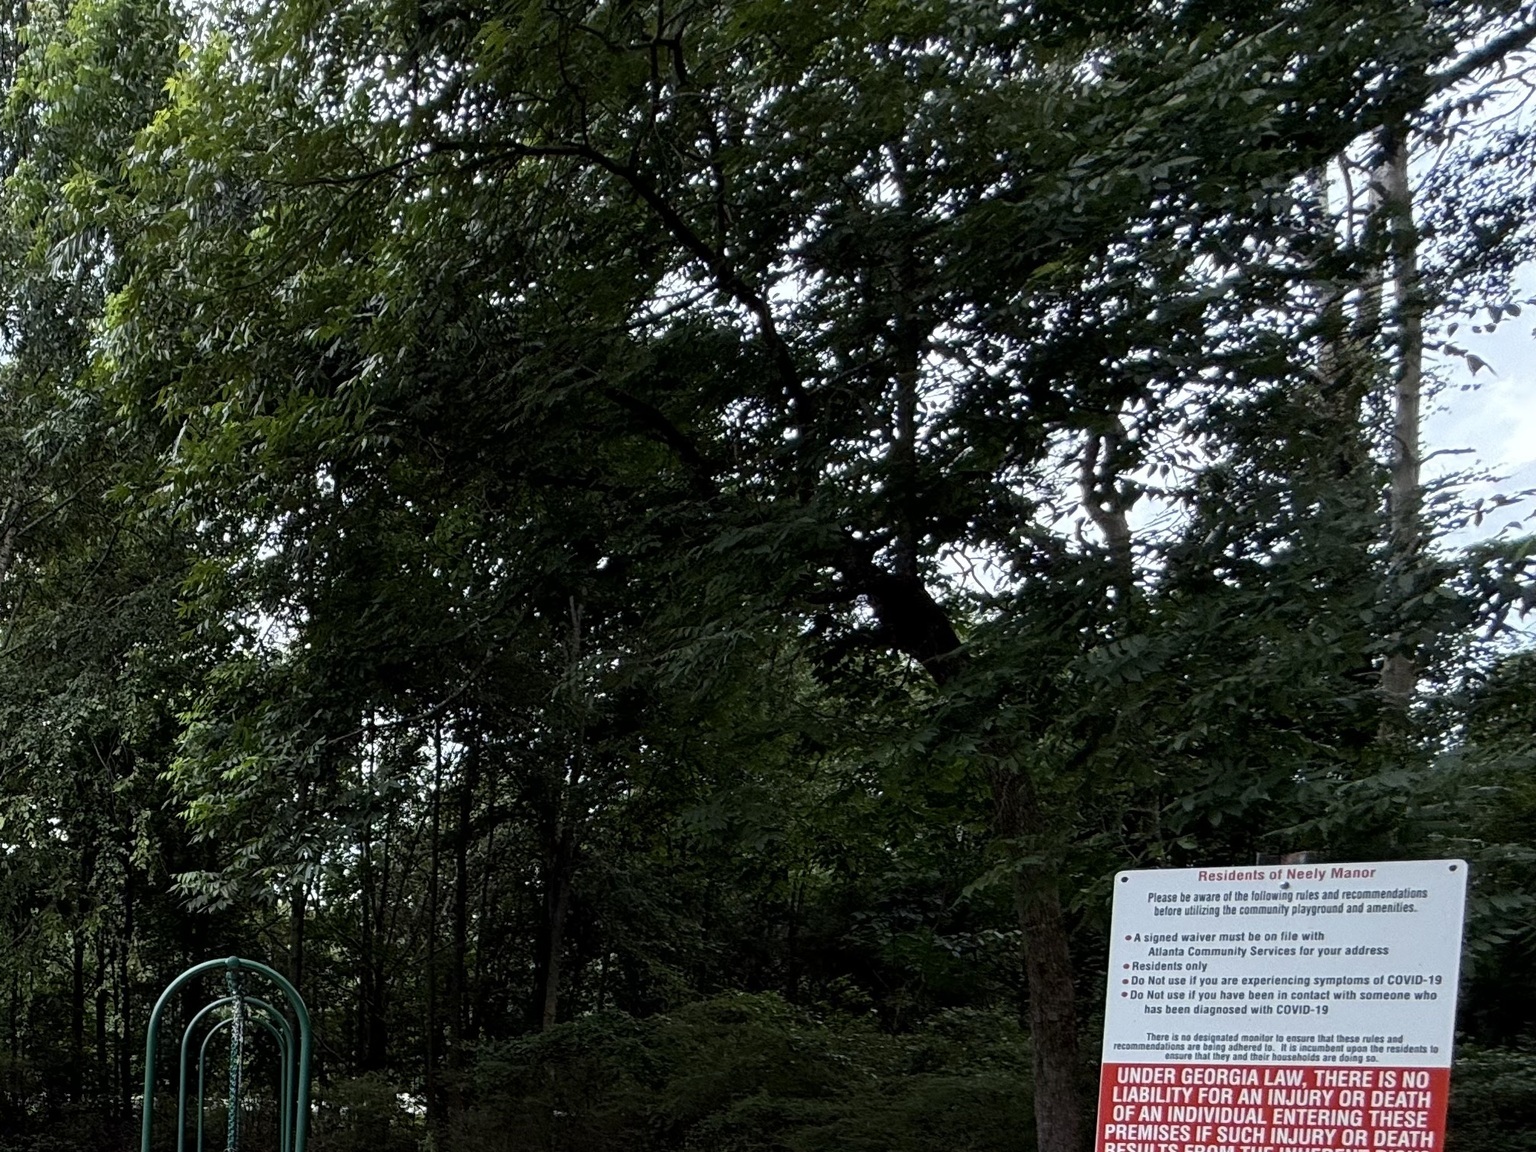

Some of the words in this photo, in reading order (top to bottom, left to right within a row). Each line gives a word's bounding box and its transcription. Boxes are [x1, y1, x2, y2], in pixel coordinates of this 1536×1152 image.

[1198, 871, 1265, 881] Residents
[1269, 869, 1282, 880] of
[1287, 868, 1326, 881] Neely
[1331, 868, 1376, 879] Manor
[1148, 892, 1177, 903] Please
[1180, 892, 1191, 902] be
[1193, 893, 1221, 902] aware
[1224, 891, 1233, 901] of
[1235, 891, 1248, 901] the
[1251, 891, 1293, 902] following
[1296, 890, 1319, 900] rules
[1322, 889, 1340, 899] and
[1342, 888, 1428, 899] recommendations
[1154, 906, 1182, 916] before
[1184, 905, 1220, 917] utilizing
[1223, 905, 1236, 915] the
[1239, 904, 1289, 916] community
[1292, 903, 1344, 916] playground
[1346, 903, 1364, 913] and
[1367, 903, 1417, 913] amenities.
[1134, 933, 1141, 942] A
[1144, 933, 1178, 944] signed
[1181, 933, 1216, 942] waiver
[1219, 933, 1245, 942] must
[1248, 931, 1261, 941] be
[1264, 933, 1277, 941] on
[1281, 931, 1298, 941] file
[1302, 931, 1325, 941] with
[1148, 947, 1185, 956] Atlanta
[1188, 946, 1247, 958] Community
[1250, 946, 1296, 956] Services
[1299, 946, 1314, 955] for
[1318, 947, 1342, 957] your
[1345, 946, 1389, 955] address
[1132, 961, 1182, 971] Residents
[1186, 961, 1208, 972] only
[1131, 976, 1145, 985] Do
[1148, 976, 1165, 985] Not
[1168, 977, 1186, 985] use
[1189, 975, 1197, 985] if
[1199, 977, 1218, 987] you
[1221, 977, 1238, 985] are
[1241, 976, 1310, 987] experiencing
[1313, 976, 1370, 987] symptoms
[1373, 975, 1384, 985] of
[1387, 975, 1442, 985] COVID-19
[1130, 990, 1143, 999] Do
[1147, 990, 1164, 999] Not
[1188, 990, 1196, 999] if
[1198, 992, 1217, 1001] you
[1220, 990, 1245, 999] have
[1248, 990, 1274, 999] been
[1277, 990, 1287, 999] in
[1291, 990, 1330, 1000] contact
[1333, 990, 1356, 1000] with
[1359, 992, 1410, 1000] someone
[1414, 990, 1437, 1000] who
[1144, 1005, 1162, 1014] has
[1165, 1005, 1190, 1014] been
[1193, 1005, 1247, 1016] diagnosed
[1251, 1005, 1273, 1014] with
[1276, 1005, 1329, 1015] COVID-19
[1146, 1033, 1169, 1041] There
[1172, 1033, 1179, 1041] is
[1193, 1033, 1238, 1043] designated
[1241, 1034, 1273, 1042] monitor
[1276, 1034, 1284, 1042] to
[1286, 1035, 1315, 1043] ensure
[1318, 1034, 1334, 1043] that
[1337, 1034, 1360, 1043] these
[1362, 1035, 1384, 1043] rules
[1387, 1035, 1403, 1043] and
[1114, 1042, 1185, 1050] recommendations
[1203, 1043, 1225, 1052] being
[1228, 1043, 1262, 1051] adhered
[1265, 1043, 1275, 1051] to.
[1281, 1043, 1287, 1051] It
[1289, 1044, 1297, 1052] is
[1299, 1044, 1344, 1052] incumbent
[1346, 1046, 1367, 1054] upon
[1370, 1045, 1384, 1053] the
[1386, 1045, 1427, 1053] residents
[1430, 1045, 1438, 1054] to
[1195, 1052, 1210, 1060] that
[1213, 1052, 1230, 1062] they
[1233, 1052, 1247, 1060] and
[1250, 1052, 1269, 1061] their
[1272, 1053, 1320, 1062] households
[1339, 1054, 1363, 1063] doing
[1117, 1067, 1176, 1084] UNDER
[1181, 1068, 1259, 1086] GEORGIA
[1264, 1069, 1307, 1088] LAW,
[1314, 1070, 1373, 1087] THERE
[1378, 1071, 1396, 1088] IS
[1402, 1071, 1430, 1089] NO
[1113, 1086, 1193, 1103] LIABILITY
[1198, 1088, 1233, 1104] FOR
[1238, 1088, 1262, 1105] AN
[1267, 1089, 1334, 1106] INJURY
[1338, 1090, 1365, 1107] OR
[1371, 1091, 1431, 1108] DEATH
[1113, 1105, 1135, 1121] OF
[1138, 1106, 1162, 1122] AN
[1167, 1106, 1267, 1125] INDIVIDUAL
[1273, 1108, 1363, 1127] ENTERING
[1368, 1110, 1428, 1128] THESE
[1105, 1124, 1190, 1141] PREMISES
[1196, 1125, 1212, 1142] IF
[1217, 1126, 1264, 1143] SUCH
[1270, 1127, 1337, 1145] INJURY
[1341, 1129, 1368, 1146] OR
[1373, 1130, 1434, 1148] DEATH
